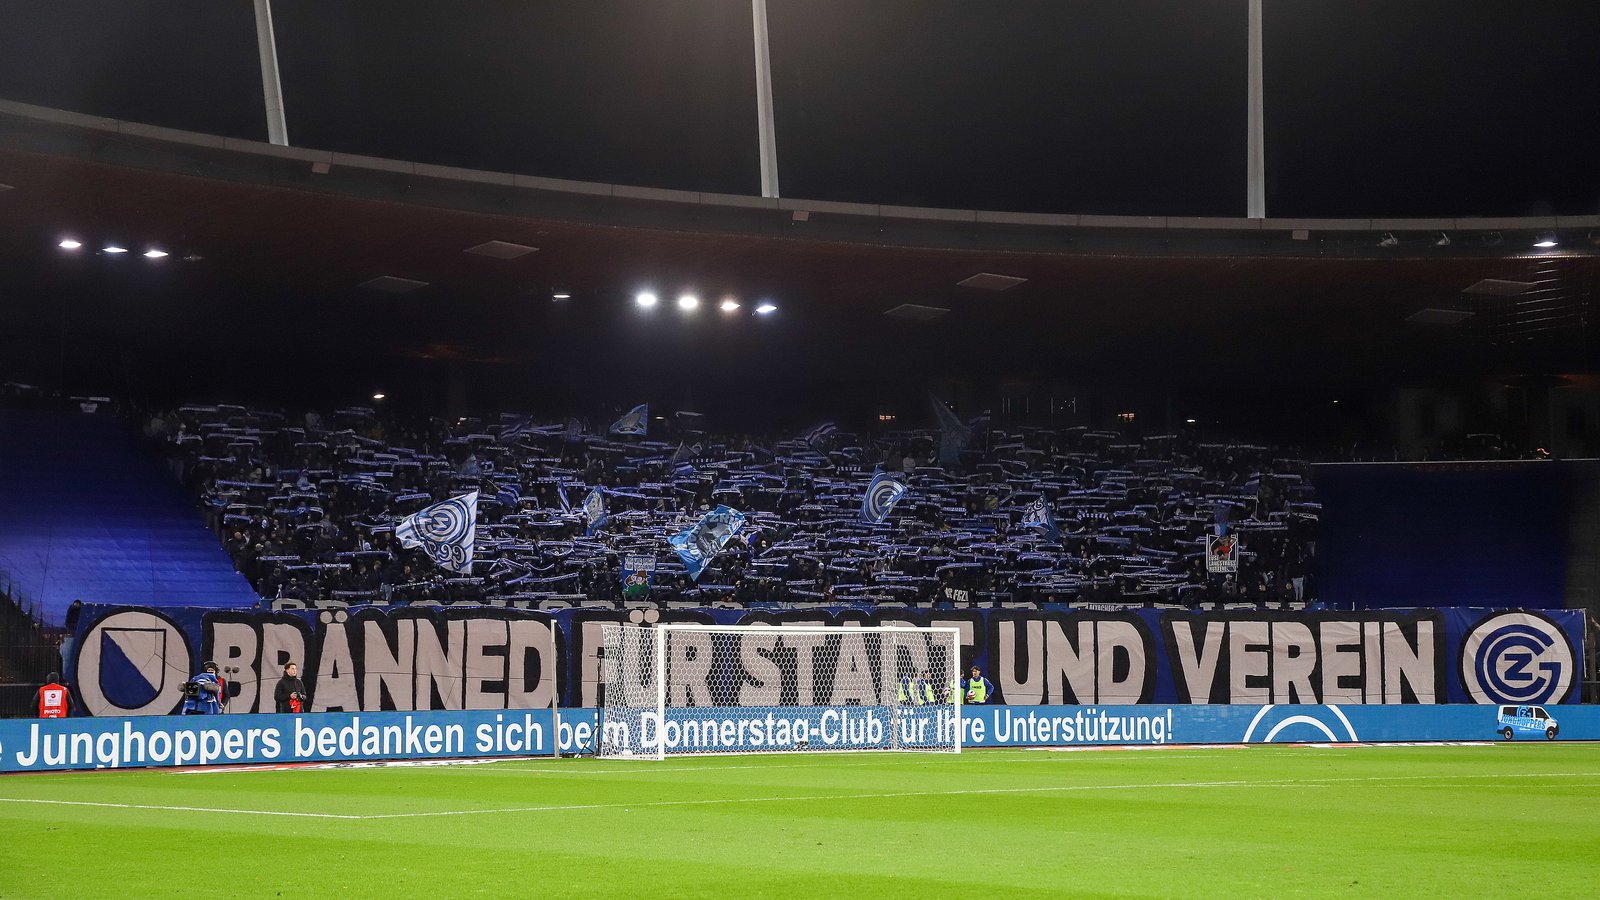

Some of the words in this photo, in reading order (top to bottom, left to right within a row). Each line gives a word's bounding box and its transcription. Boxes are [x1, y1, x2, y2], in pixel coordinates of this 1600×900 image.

[212, 610, 554, 714] BRÄNNED
[582, 609, 712, 708] FÜR
[739, 620, 974, 706] STADT
[998, 620, 1146, 706] UND
[1171, 620, 1436, 705] VEREIN
[16, 720, 281, 768] Junghoppers
[294, 715, 464, 757] bedanken
[475, 713, 543, 753] sich
[557, 712, 629, 750] beim
[937, 709, 985, 743] Ihre
[994, 708, 1173, 744] Unterstützung!
